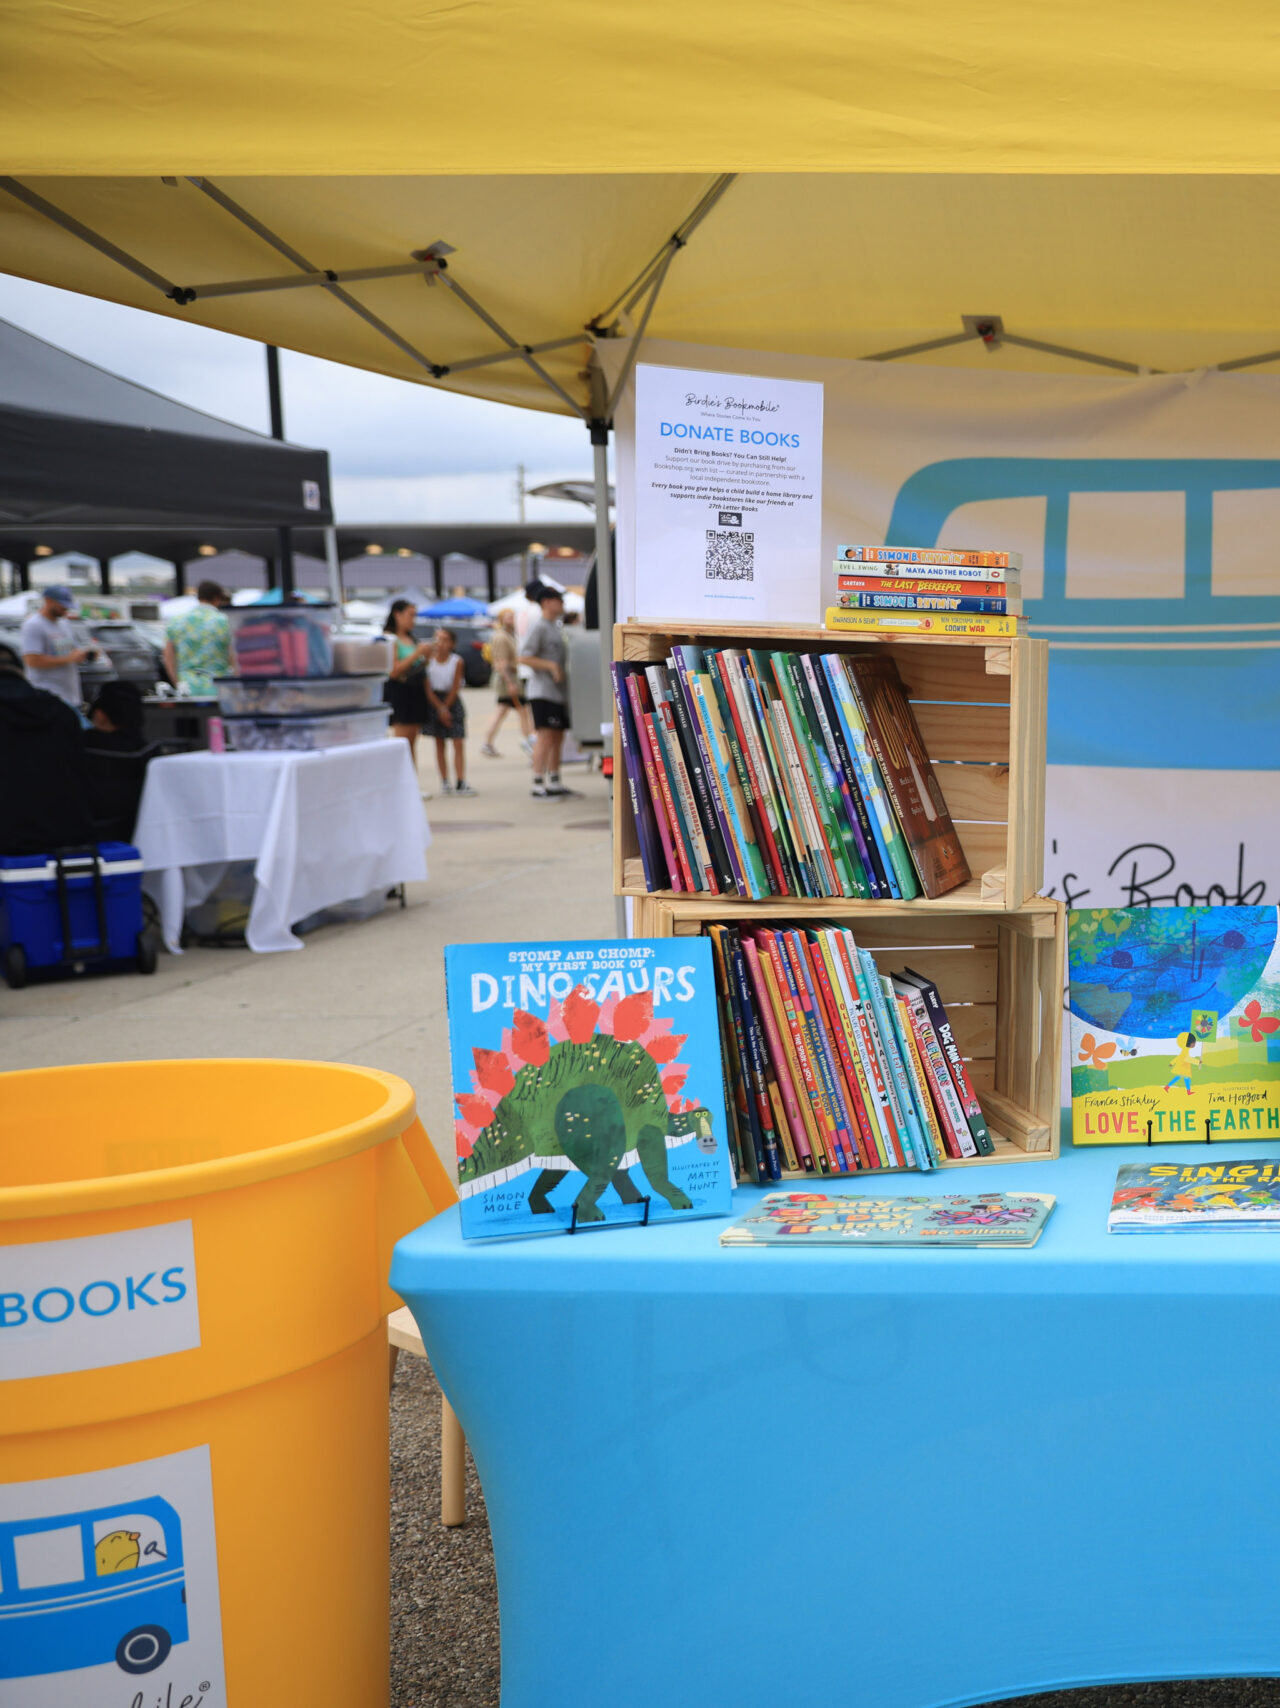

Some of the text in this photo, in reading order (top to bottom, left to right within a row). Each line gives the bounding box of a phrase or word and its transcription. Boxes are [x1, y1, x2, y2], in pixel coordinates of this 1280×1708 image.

[685, 393, 722, 408] Birdie's
[660, 422, 800, 449] DONATE BOOKS
[878, 550, 909, 562] SIMON
[911, 551, 920, 562] B.
[906, 567, 926, 575] MAYA
[880, 580, 962, 594] THE LAST BEEKEEPER
[874, 595, 905, 608] SIMON
[907, 596, 916, 608] B.
[730, 740, 744, 776] TOGETHER,
[743, 784, 754, 806] FOREST
[696, 774, 716, 830] TWENTY YAWNS
[508, 948, 656, 962] STOMP AND CHOMP:
[522, 959, 646, 972] MY FIRST BOOK OF
[471, 966, 696, 1012] DINOSAURS
[840, 1003, 859, 1058] OLIVIA
[866, 1002, 885, 1057] OLIVIA
[938, 1022, 961, 1064] DOG MAN
[861, 1018, 884, 1087] OLIVIA
[1084, 1095, 1118, 1107] Frances
[1208, 1090, 1267, 1108] Tom Hopgood
[830, 1094, 842, 1122] WORDS
[1085, 1107, 1280, 1136] LOVE, THE EARTH
[688, 1170, 720, 1181] MATT
[689, 1181, 719, 1191] HUNT
[483, 1191, 525, 1204] SIMON
[807, 1200, 896, 1209] Busy
[0, 1267, 187, 1328] BOOKS
